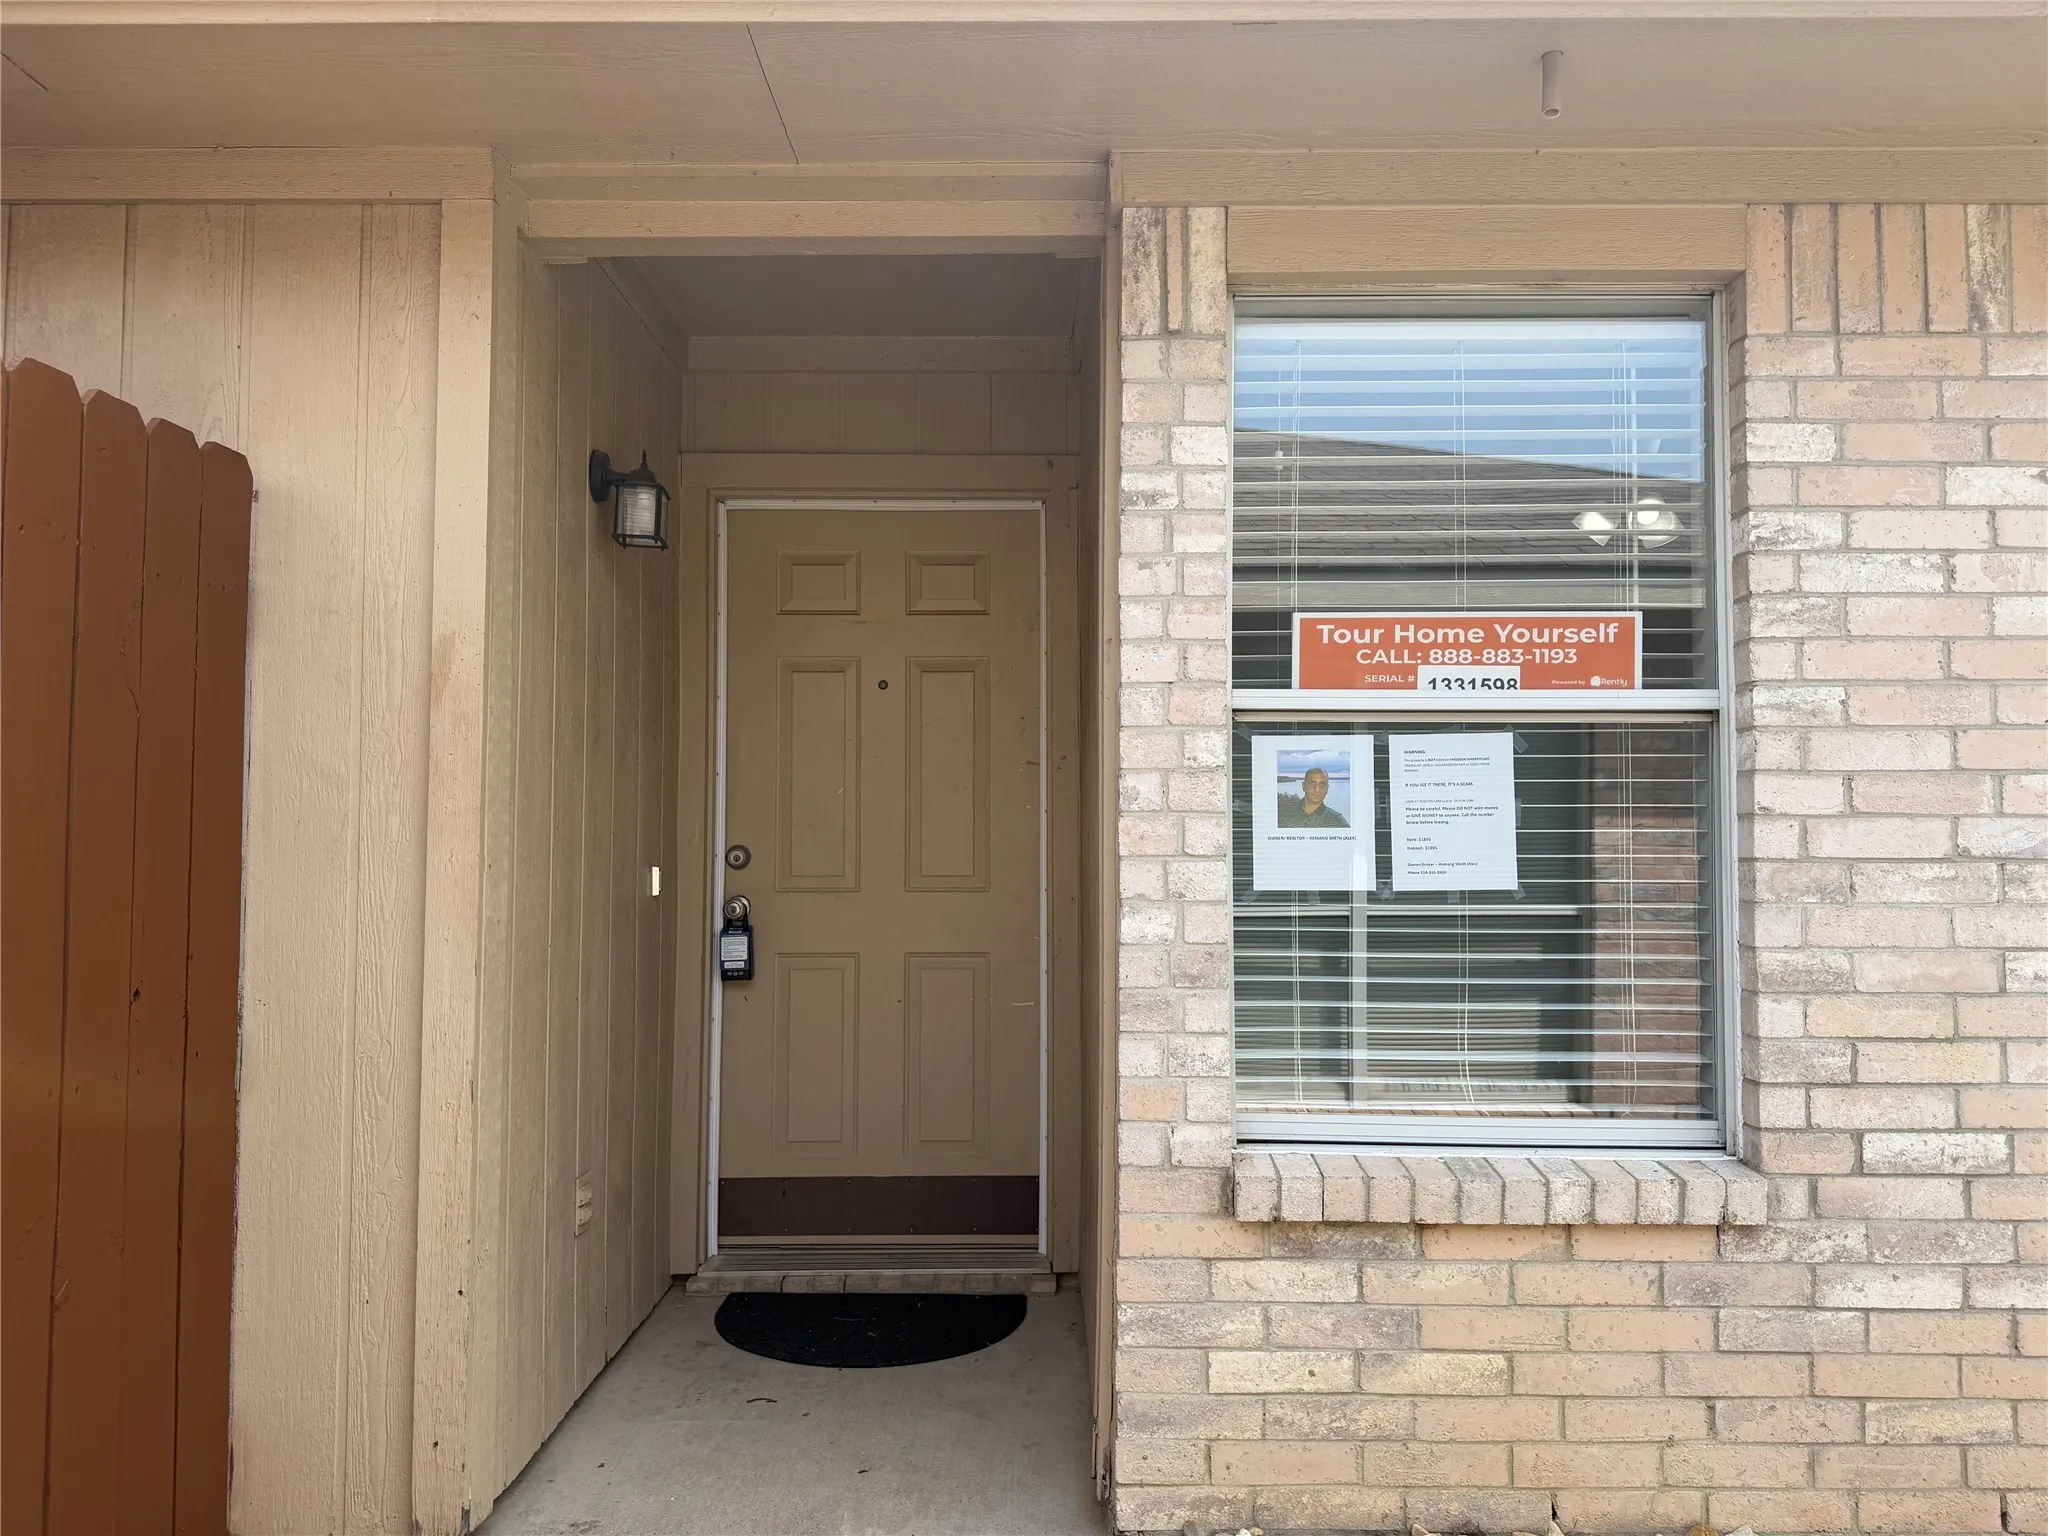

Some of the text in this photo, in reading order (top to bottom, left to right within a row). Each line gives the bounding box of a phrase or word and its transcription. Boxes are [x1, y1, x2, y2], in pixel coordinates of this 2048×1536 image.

[1316, 622, 1619, 645] Tour Home Yourself
[1356, 648, 1578, 664] CALL: 888-883-1193
[1364, 674, 1416, 683] SERIAL #
[1601, 677, 1628, 688] Rently
